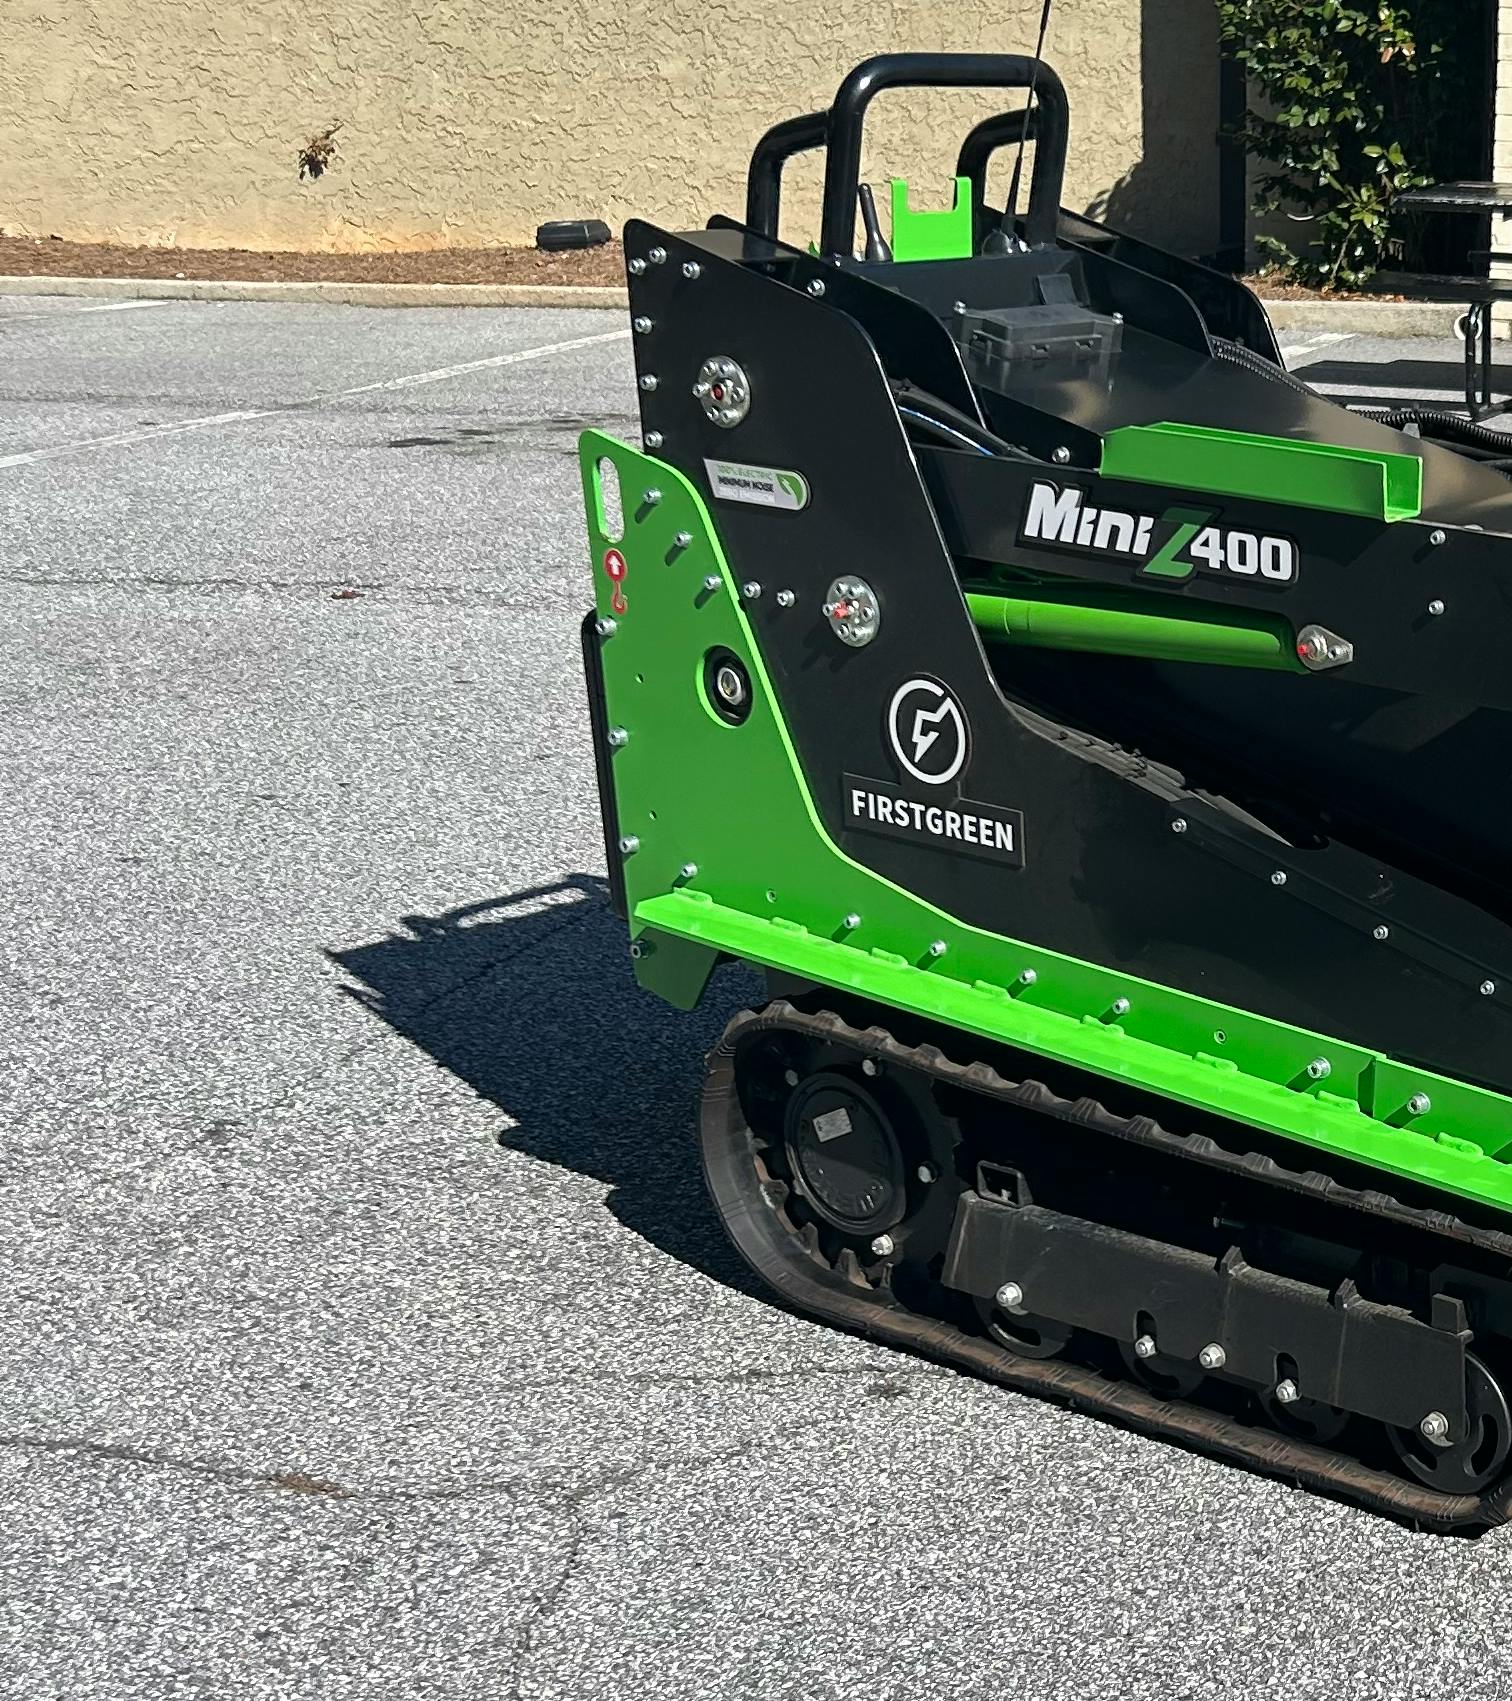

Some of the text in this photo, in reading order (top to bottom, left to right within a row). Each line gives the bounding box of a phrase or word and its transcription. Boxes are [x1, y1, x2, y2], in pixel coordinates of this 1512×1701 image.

[718, 475, 774, 492] MINIMUM NOISE
[1024, 482, 1154, 556] Mini
[851, 789, 1014, 852] FIRSTGREEN
